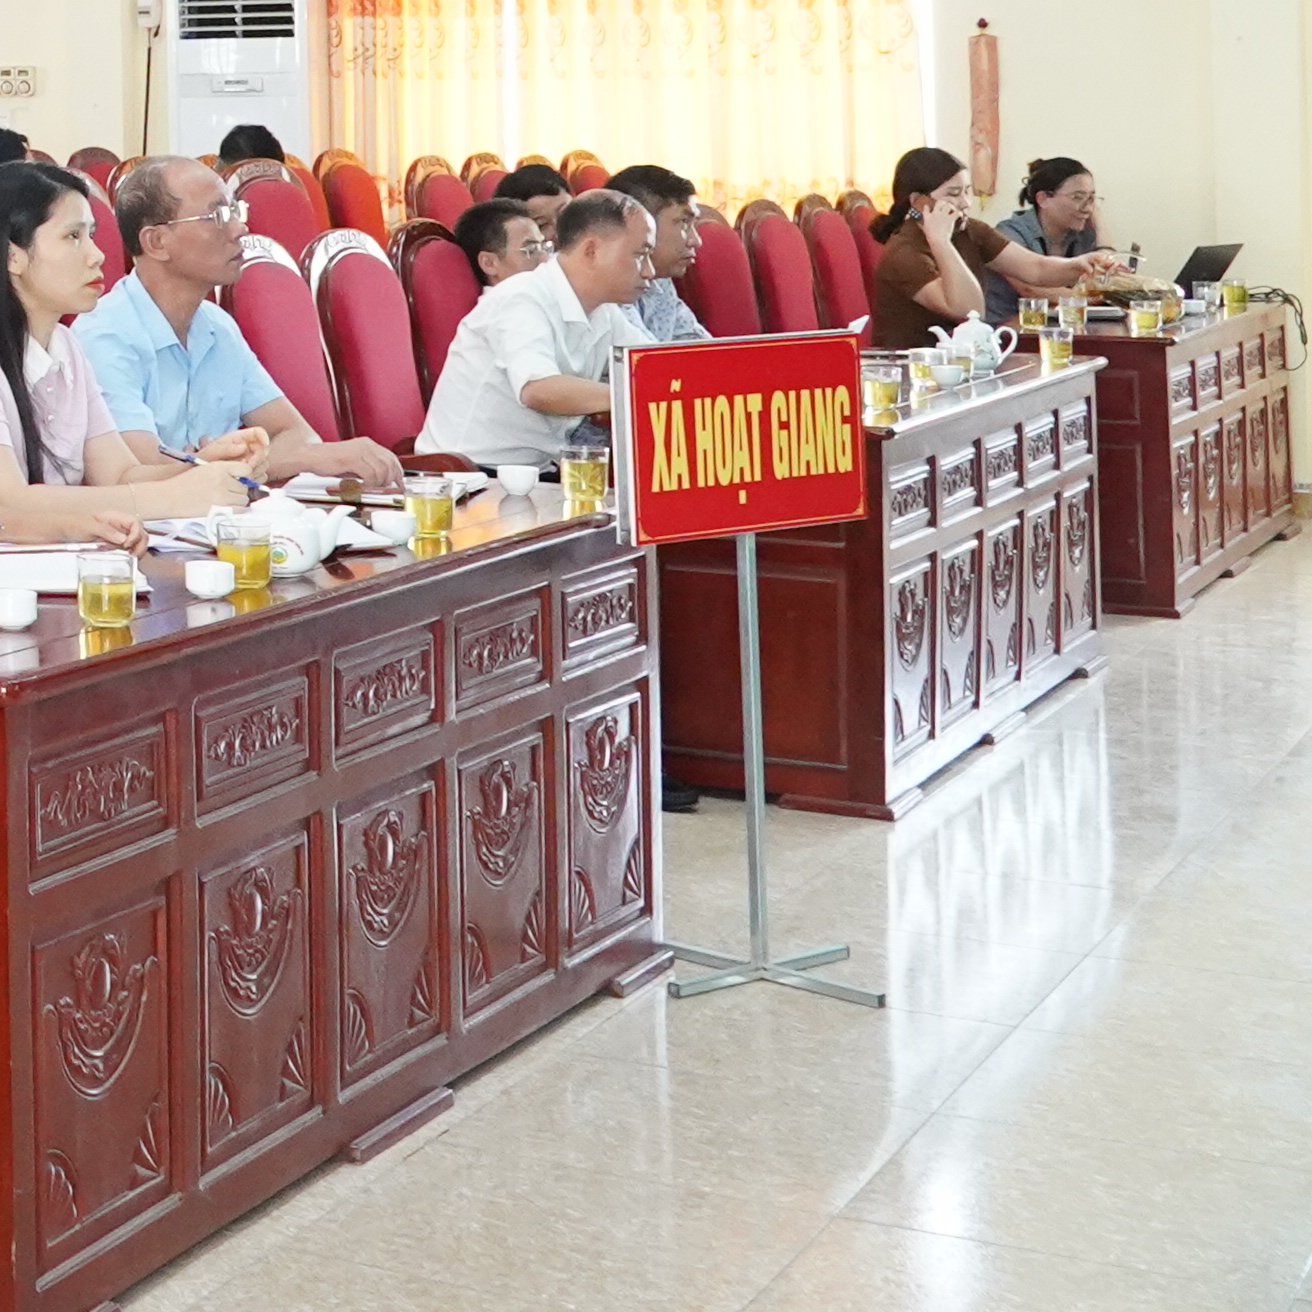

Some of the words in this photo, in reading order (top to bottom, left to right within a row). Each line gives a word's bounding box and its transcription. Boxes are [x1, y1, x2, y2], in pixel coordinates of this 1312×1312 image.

[648, 378, 691, 493] XÃ
[693, 392, 763, 505] HOẠT
[770, 384, 853, 481] GIANG
